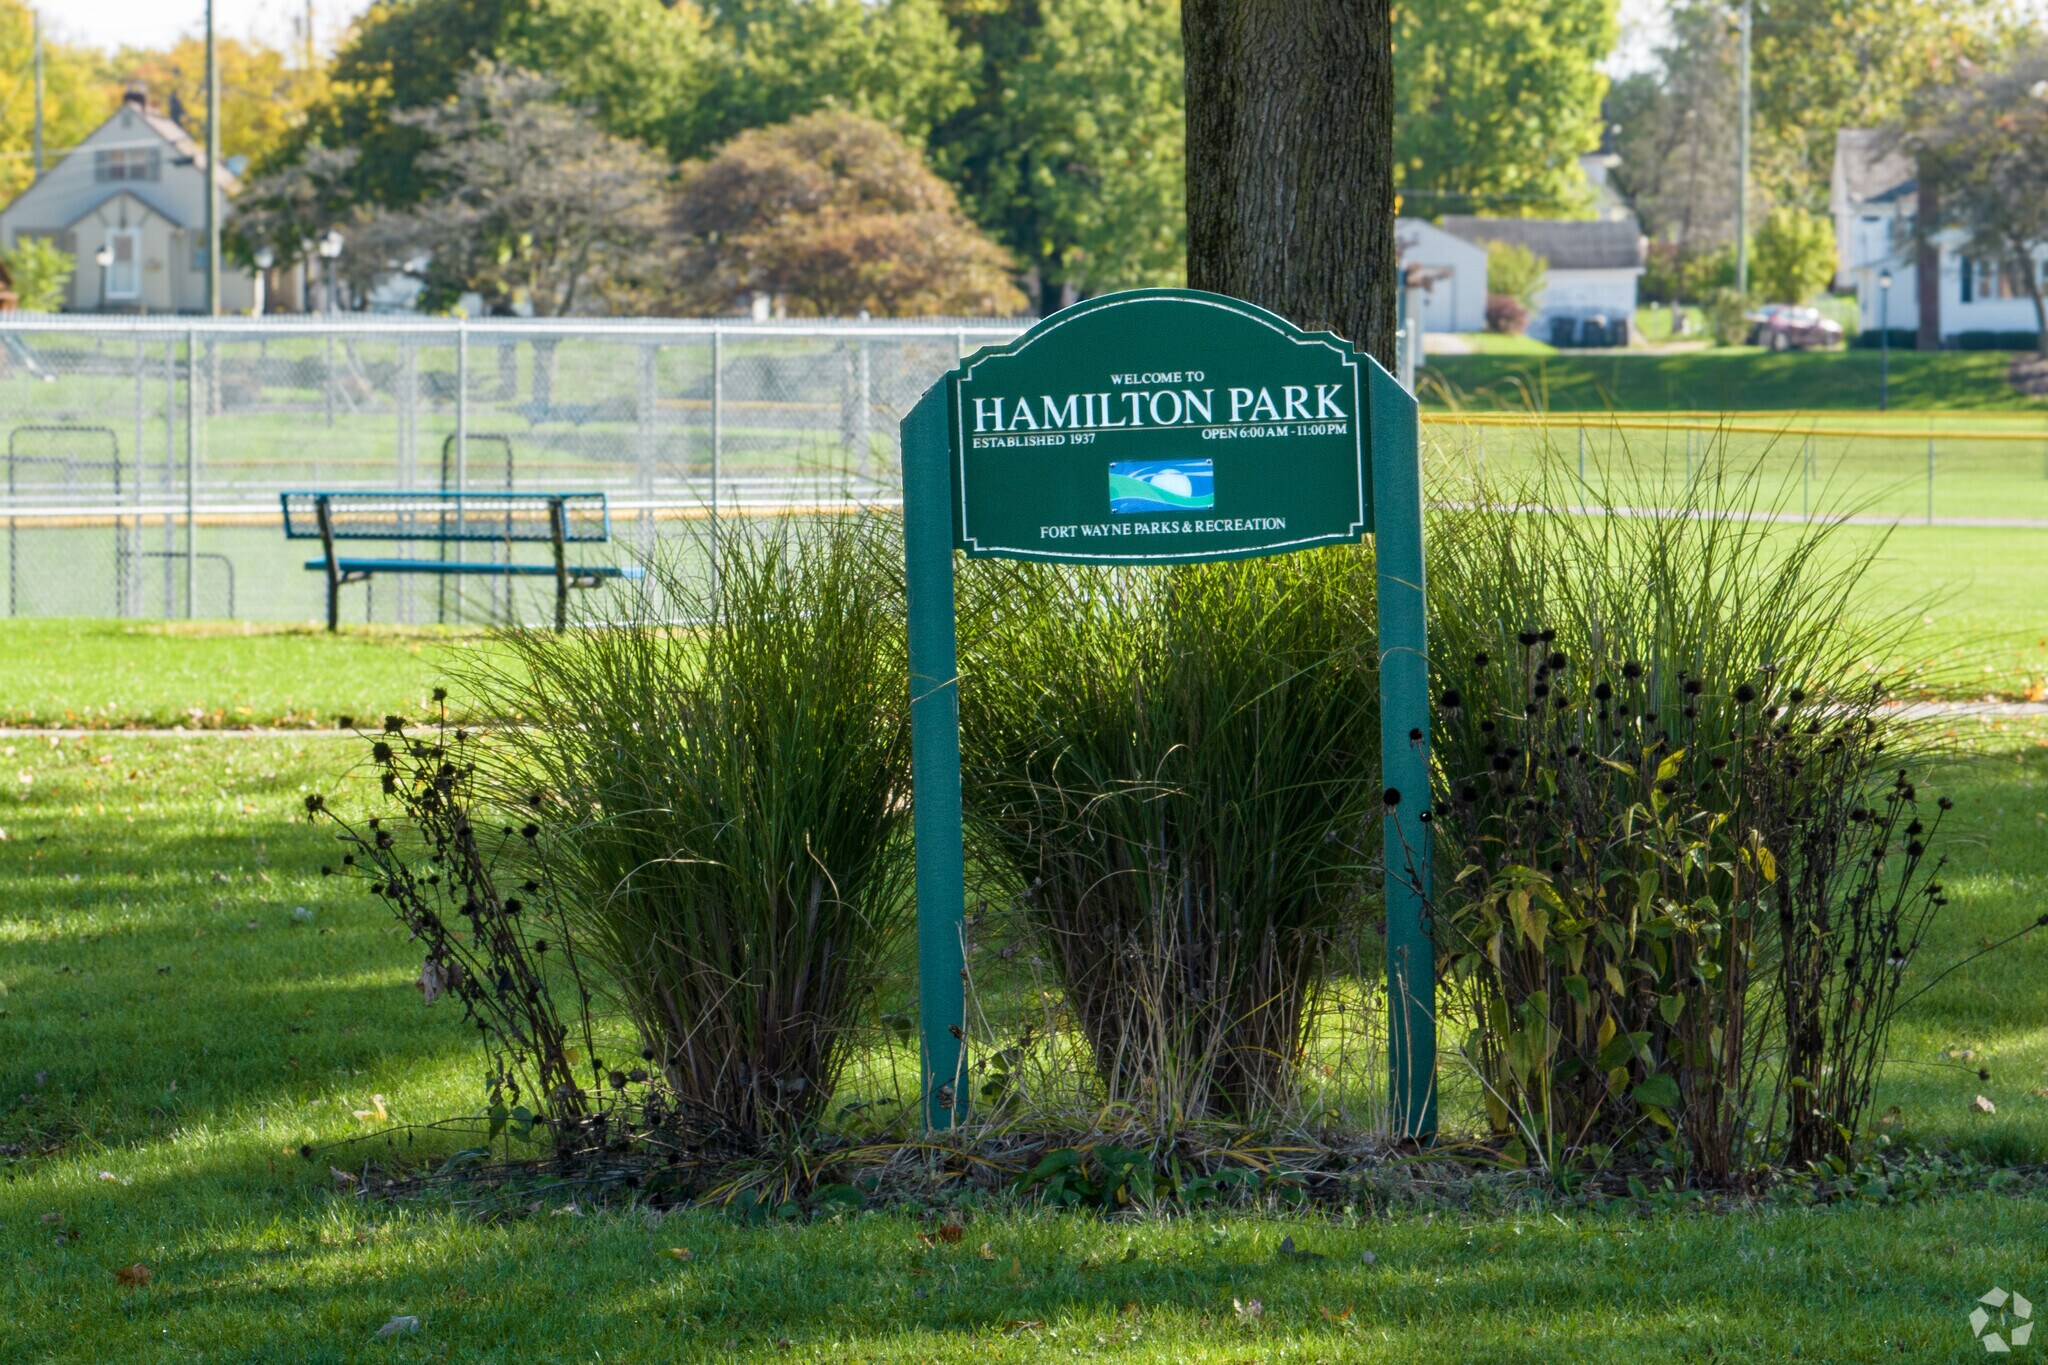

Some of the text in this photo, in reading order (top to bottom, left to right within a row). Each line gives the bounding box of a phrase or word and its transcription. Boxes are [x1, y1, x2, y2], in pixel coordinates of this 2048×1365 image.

[1111, 371, 1205, 385] WELCOME TO
[973, 384, 1348, 432] HAMILTON PARK
[1201, 427, 1237, 440] OPEN
[1240, 426, 1265, 438] 6:00
[1266, 425, 1288, 437] AM
[1297, 424, 1326, 436] 11:00
[1327, 424, 1348, 435] PM
[973, 433, 1096, 448] ESTABLISHED 1937
[1040, 517, 1286, 539] FORT WAYNE PARKS & RECREATION
